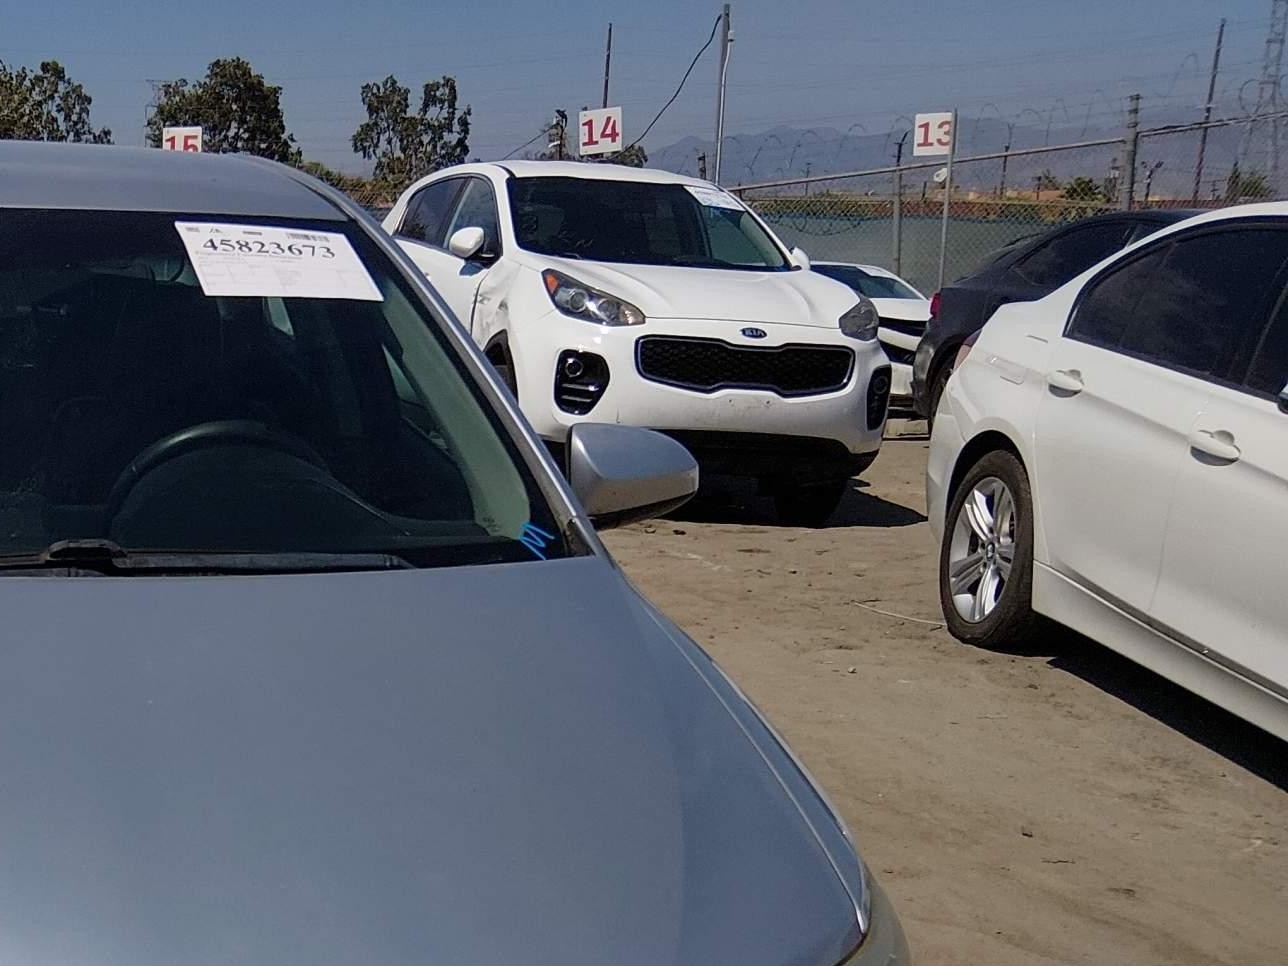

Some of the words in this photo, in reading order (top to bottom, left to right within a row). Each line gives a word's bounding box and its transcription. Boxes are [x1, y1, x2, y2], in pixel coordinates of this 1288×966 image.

[582, 116, 619, 146] 14
[917, 121, 952, 147] 13
[203, 238, 336, 259] 45823673
